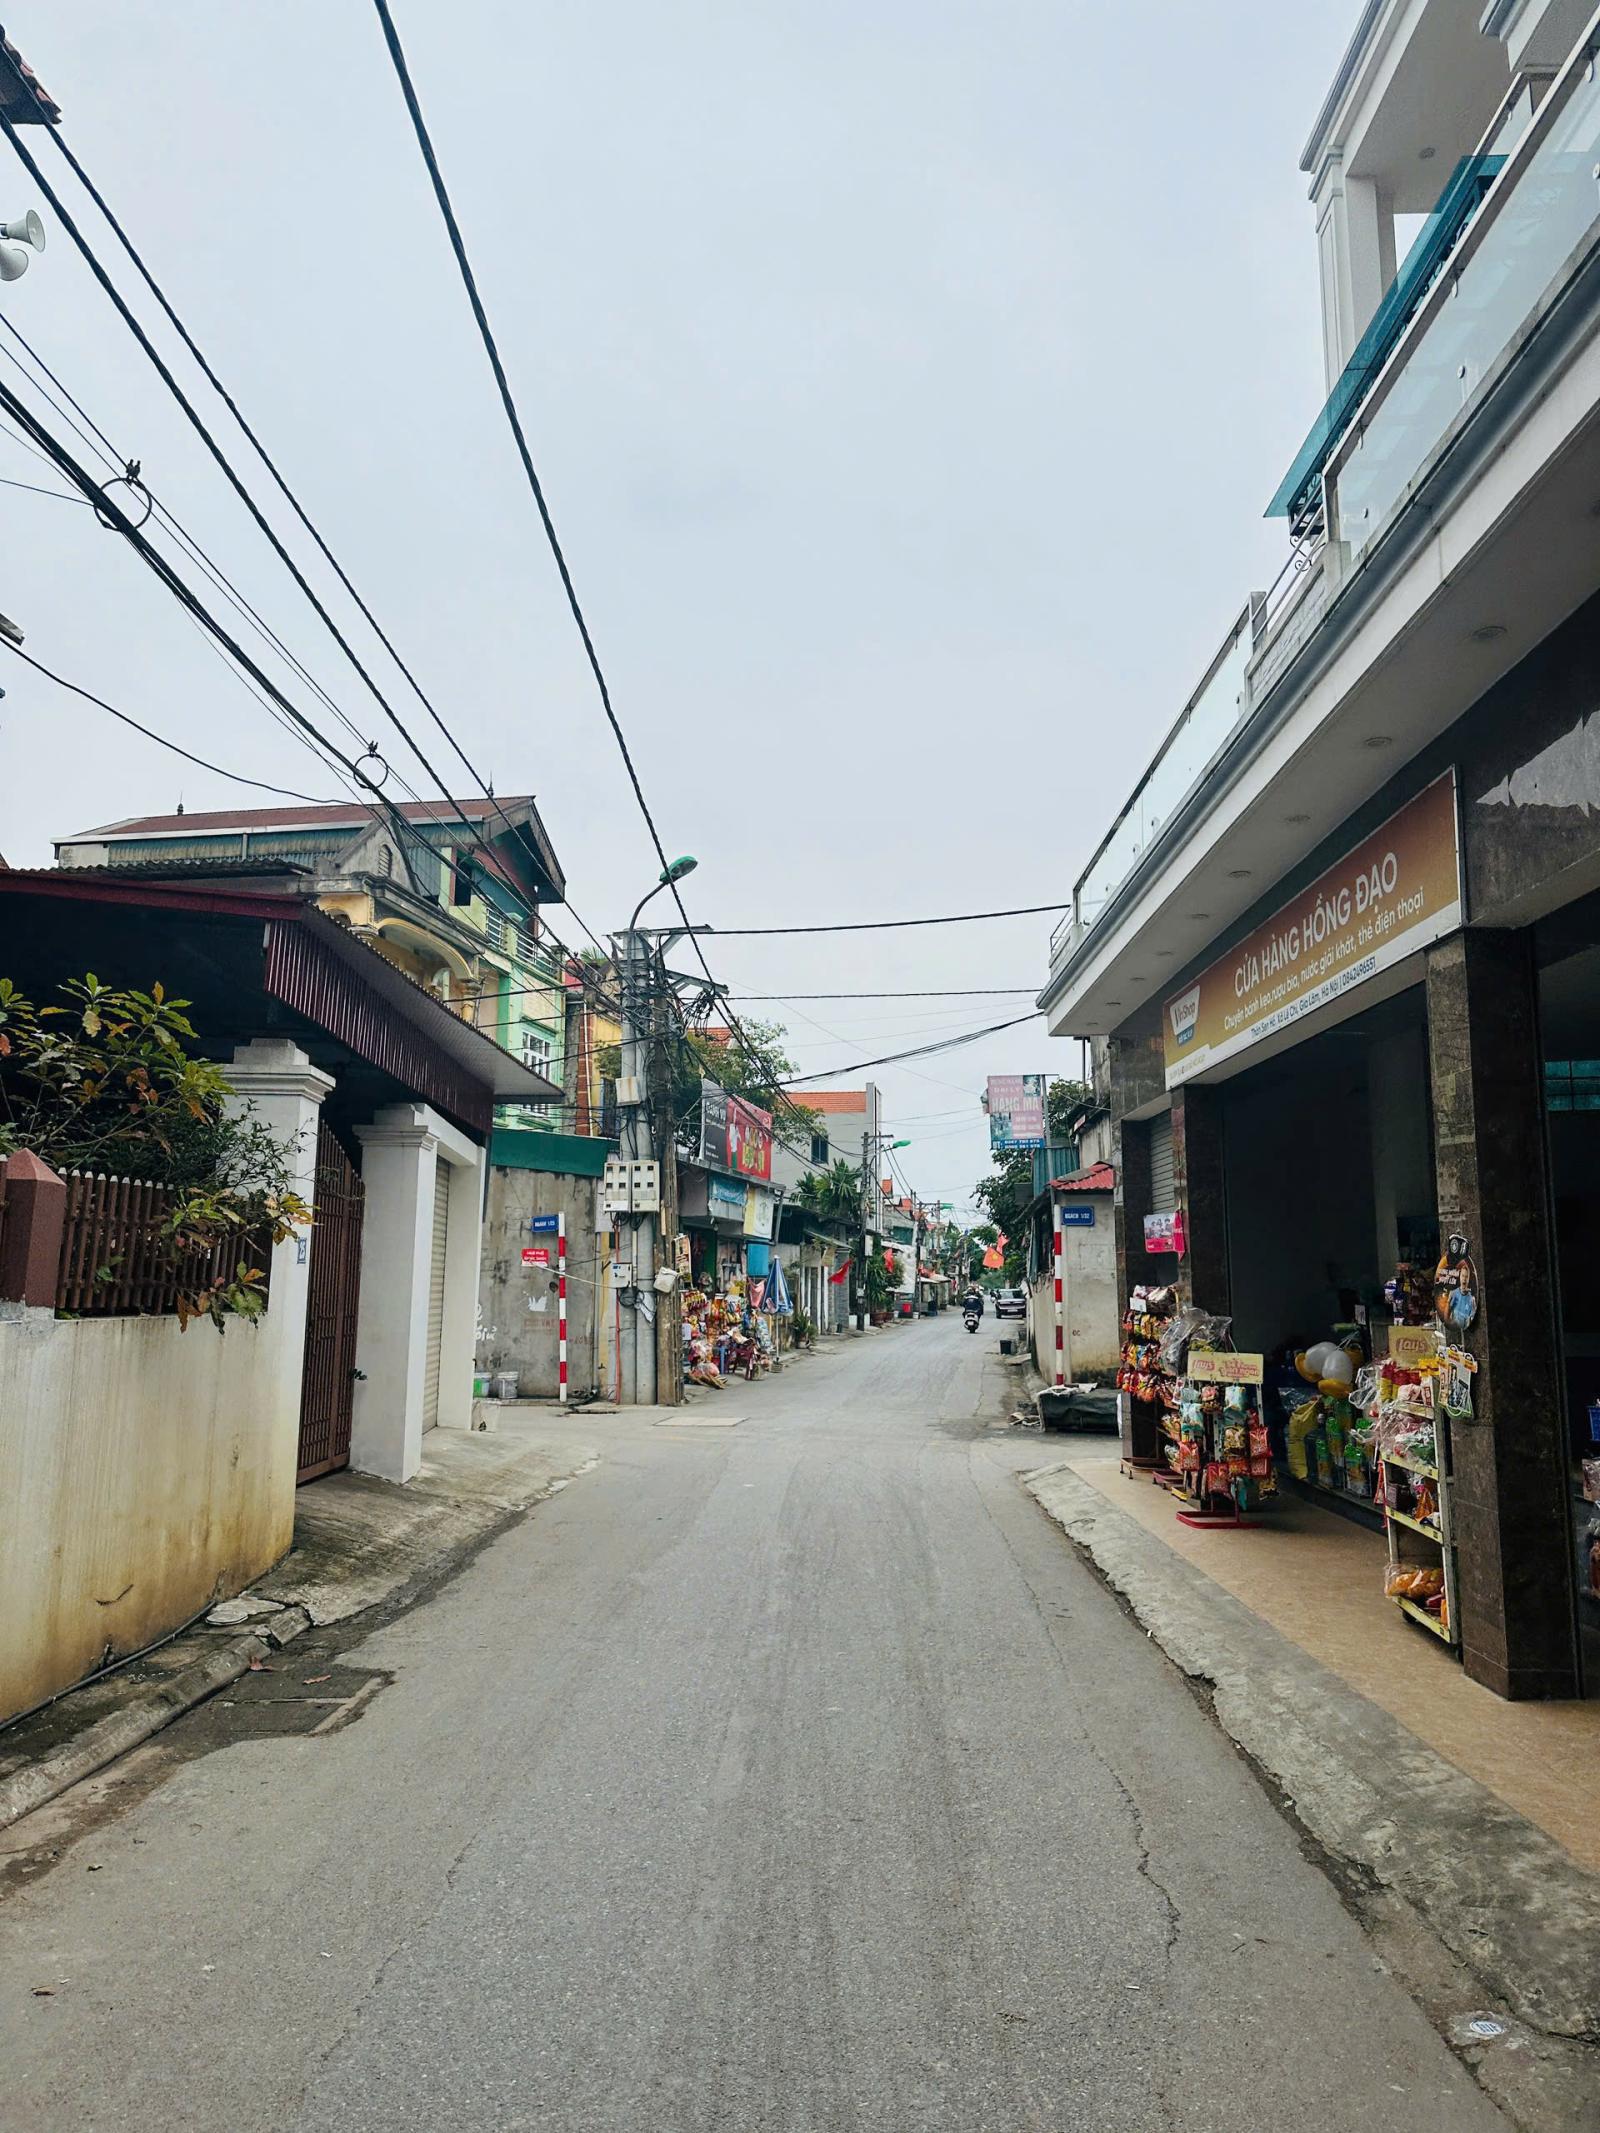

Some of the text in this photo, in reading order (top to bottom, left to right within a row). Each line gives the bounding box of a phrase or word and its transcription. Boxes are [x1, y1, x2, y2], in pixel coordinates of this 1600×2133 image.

[1234, 852, 1398, 998] CỬA HÀNG HỒNG ĐẠO
[1301, 960, 1319, 984] nước
[1319, 947, 1334, 975] giải
[1358, 920, 1373, 945] thẻ
[1375, 910, 1395, 934] điện
[1397, 886, 1424, 920] thoại
